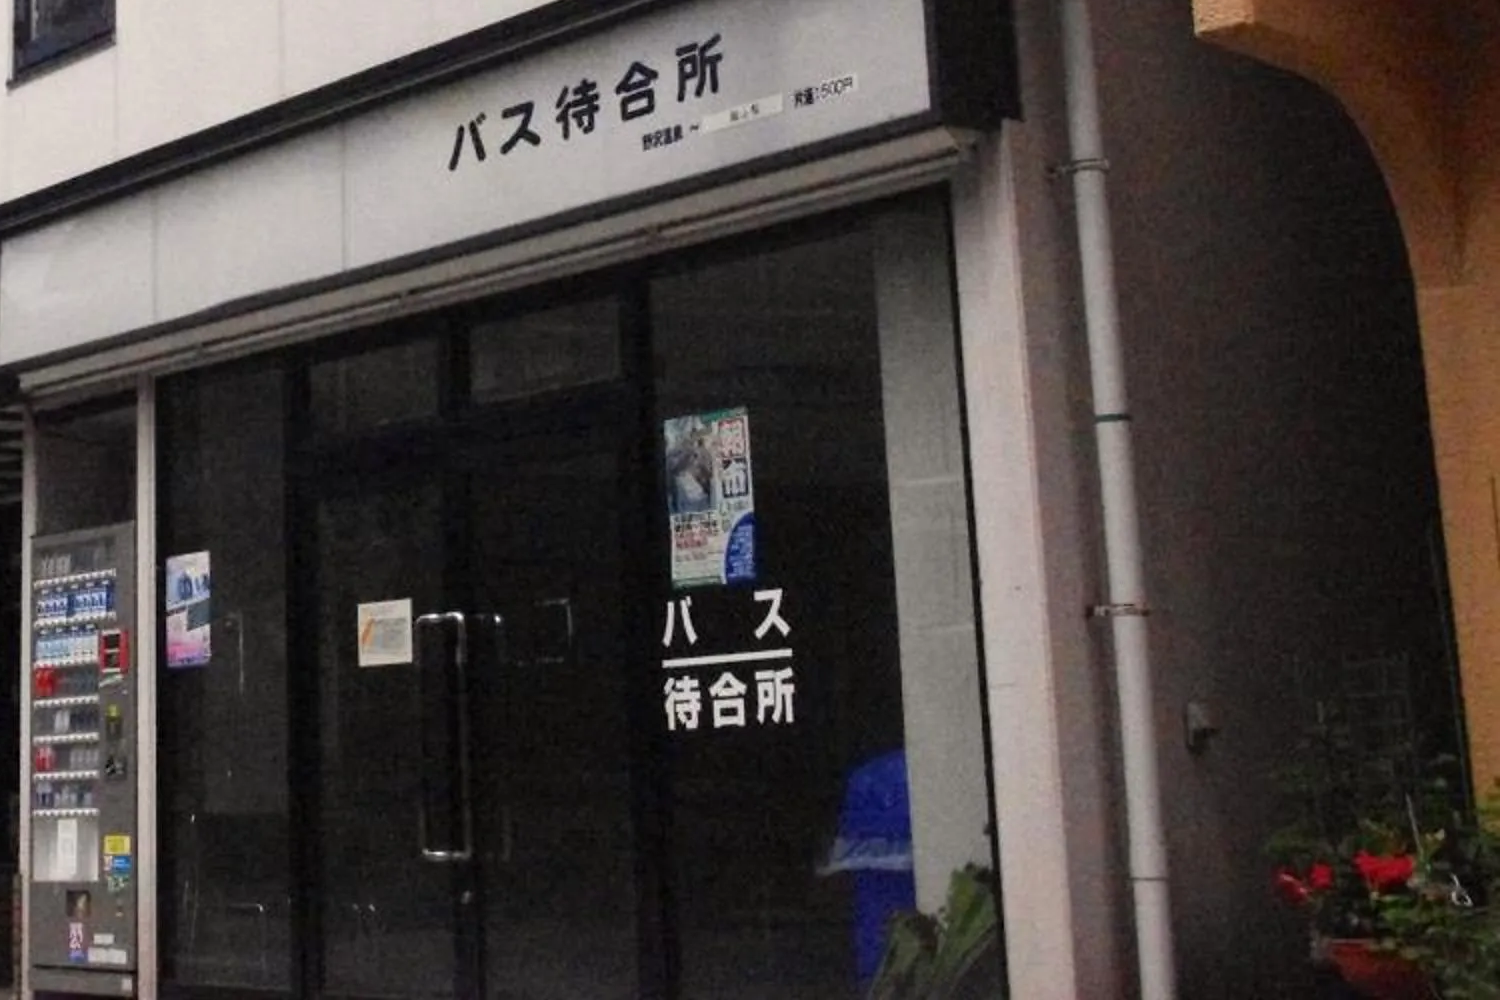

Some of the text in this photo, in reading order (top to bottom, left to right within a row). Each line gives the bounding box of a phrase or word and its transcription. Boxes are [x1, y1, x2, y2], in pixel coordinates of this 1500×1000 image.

[447, 33, 724, 171] バス待合所
[664, 668, 795, 731] 待合所
